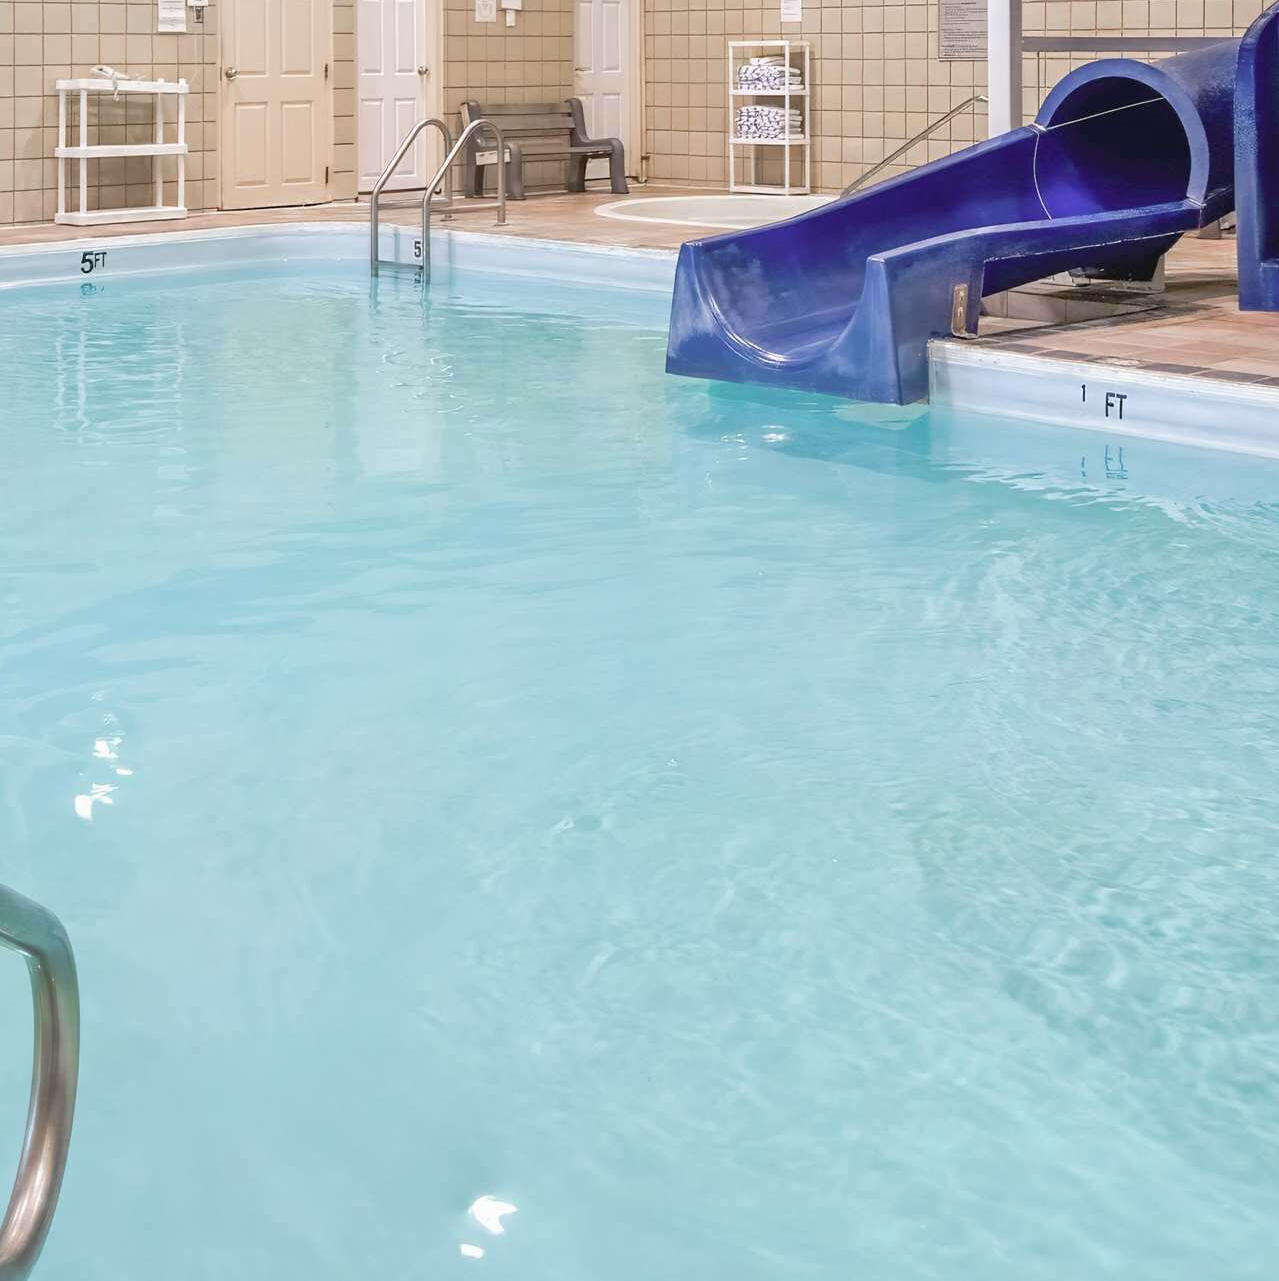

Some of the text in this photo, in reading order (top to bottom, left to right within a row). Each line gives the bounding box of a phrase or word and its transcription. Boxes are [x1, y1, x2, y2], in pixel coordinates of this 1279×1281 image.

[414, 240, 422, 258] 5
[1081, 384, 1128, 420] 1 FT
